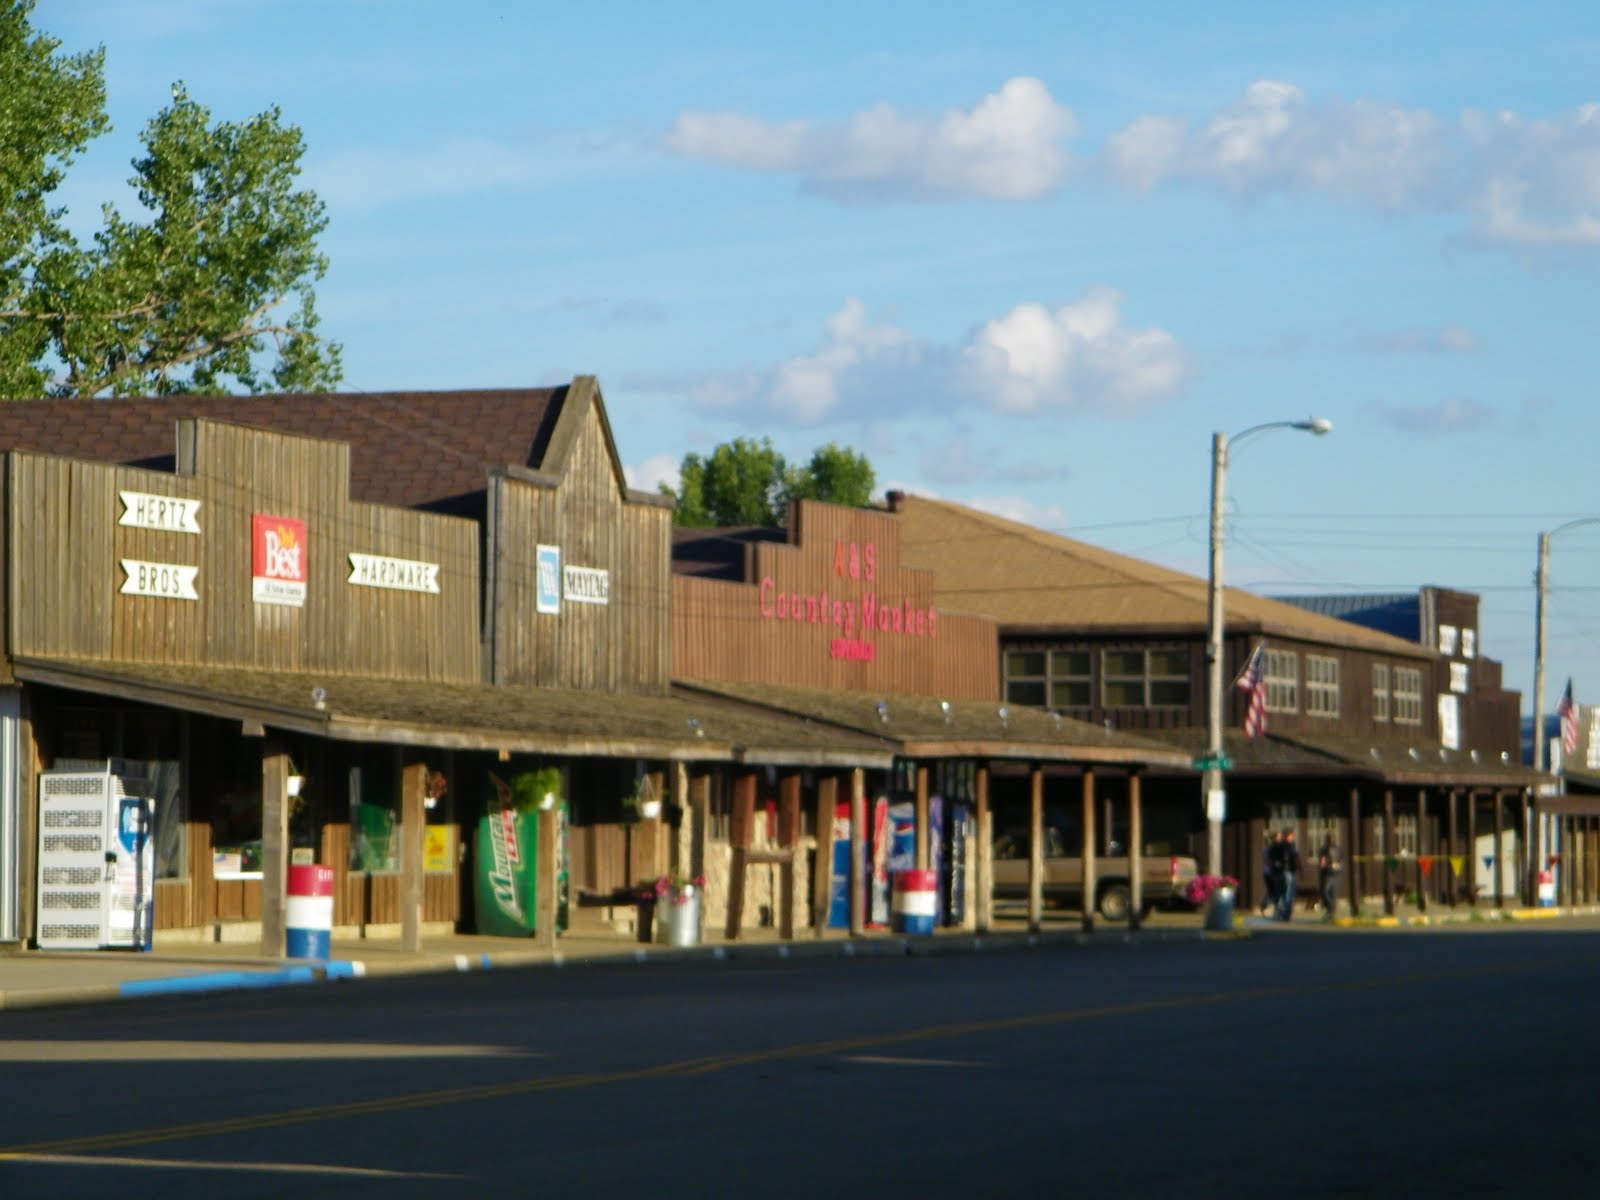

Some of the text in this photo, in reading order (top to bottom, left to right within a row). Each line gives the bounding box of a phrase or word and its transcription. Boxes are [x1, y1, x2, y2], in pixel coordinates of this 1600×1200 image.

[136, 498, 187, 529] HERTZ
[264, 530, 302, 579] Best
[361, 558, 431, 589] HARDWARE
[567, 571, 607, 598] MAYTAG
[760, 576, 937, 639] Country Market
